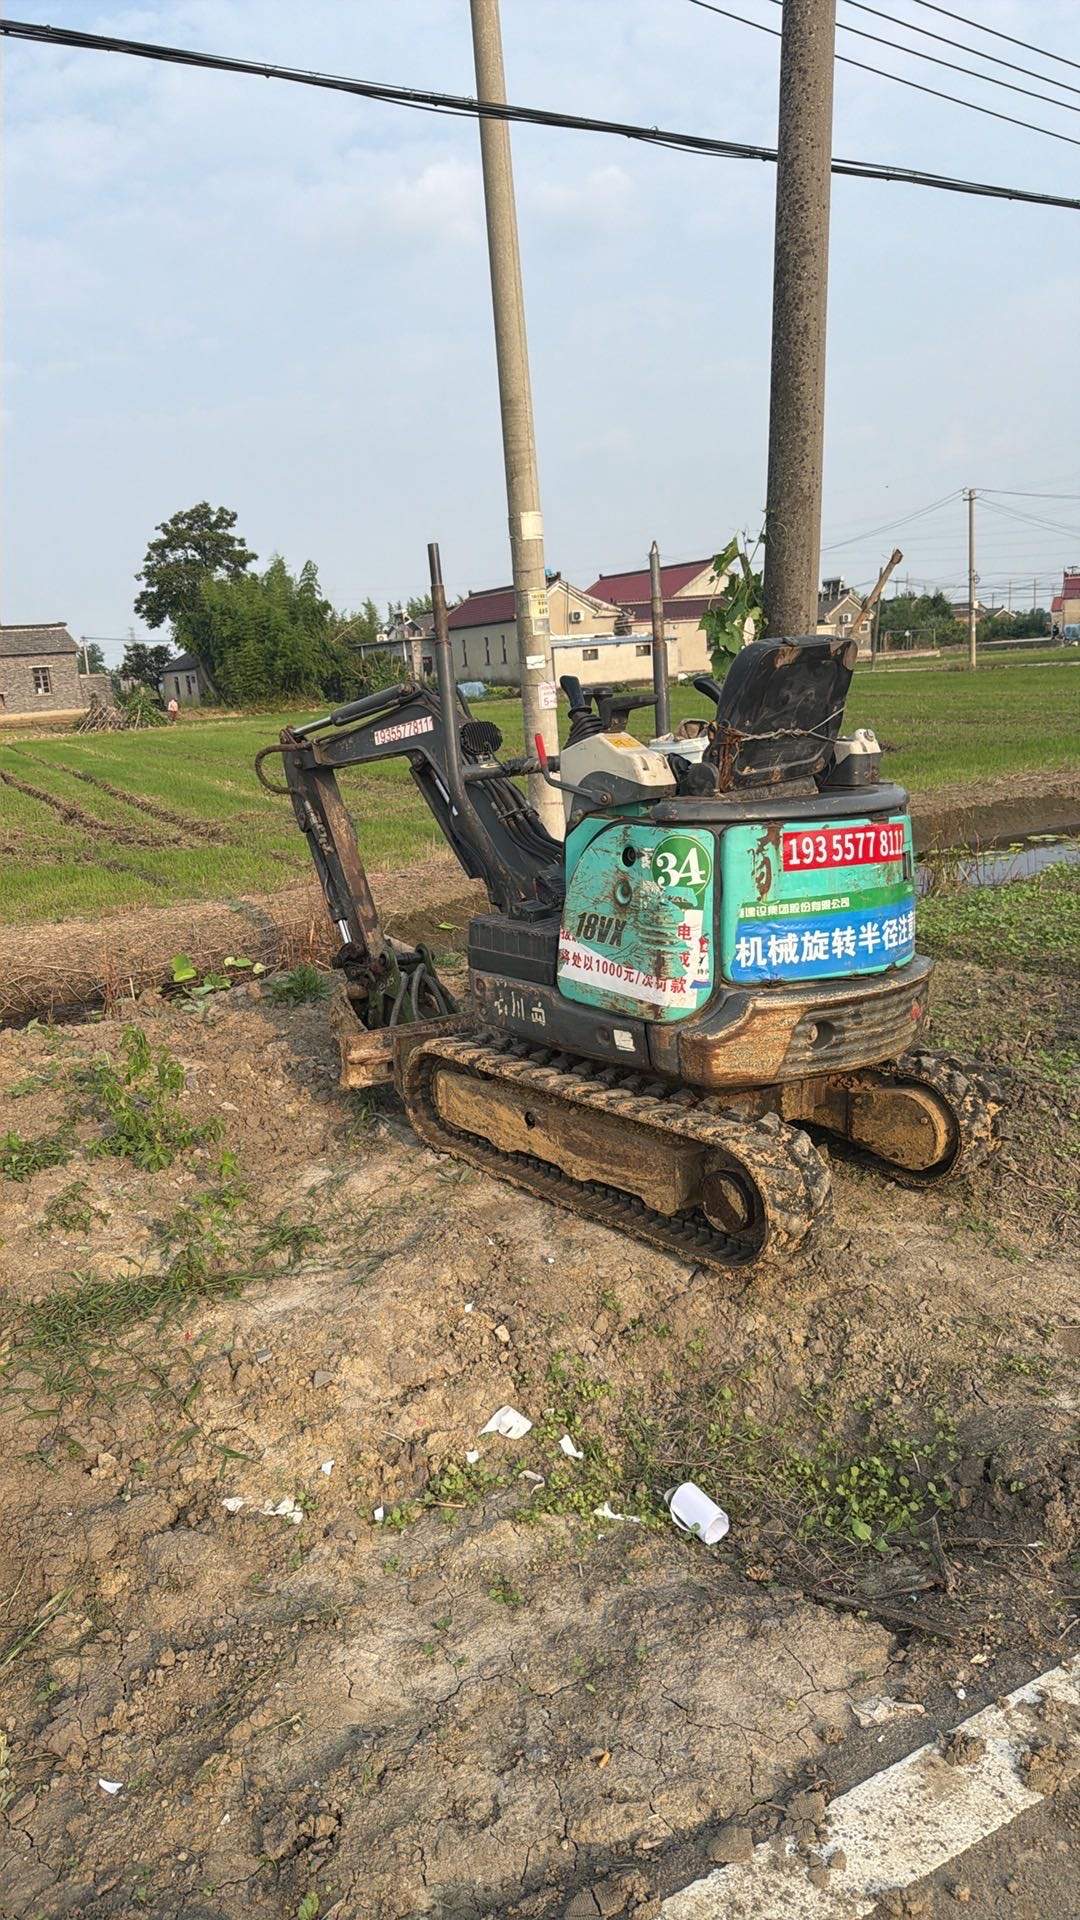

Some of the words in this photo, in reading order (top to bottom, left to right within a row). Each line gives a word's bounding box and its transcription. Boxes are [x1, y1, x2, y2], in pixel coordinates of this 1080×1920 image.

[789, 836, 829, 865] 193
[832, 831, 875, 861] 5577
[656, 847, 706, 889] 34
[575, 912, 627, 947] 18VX
